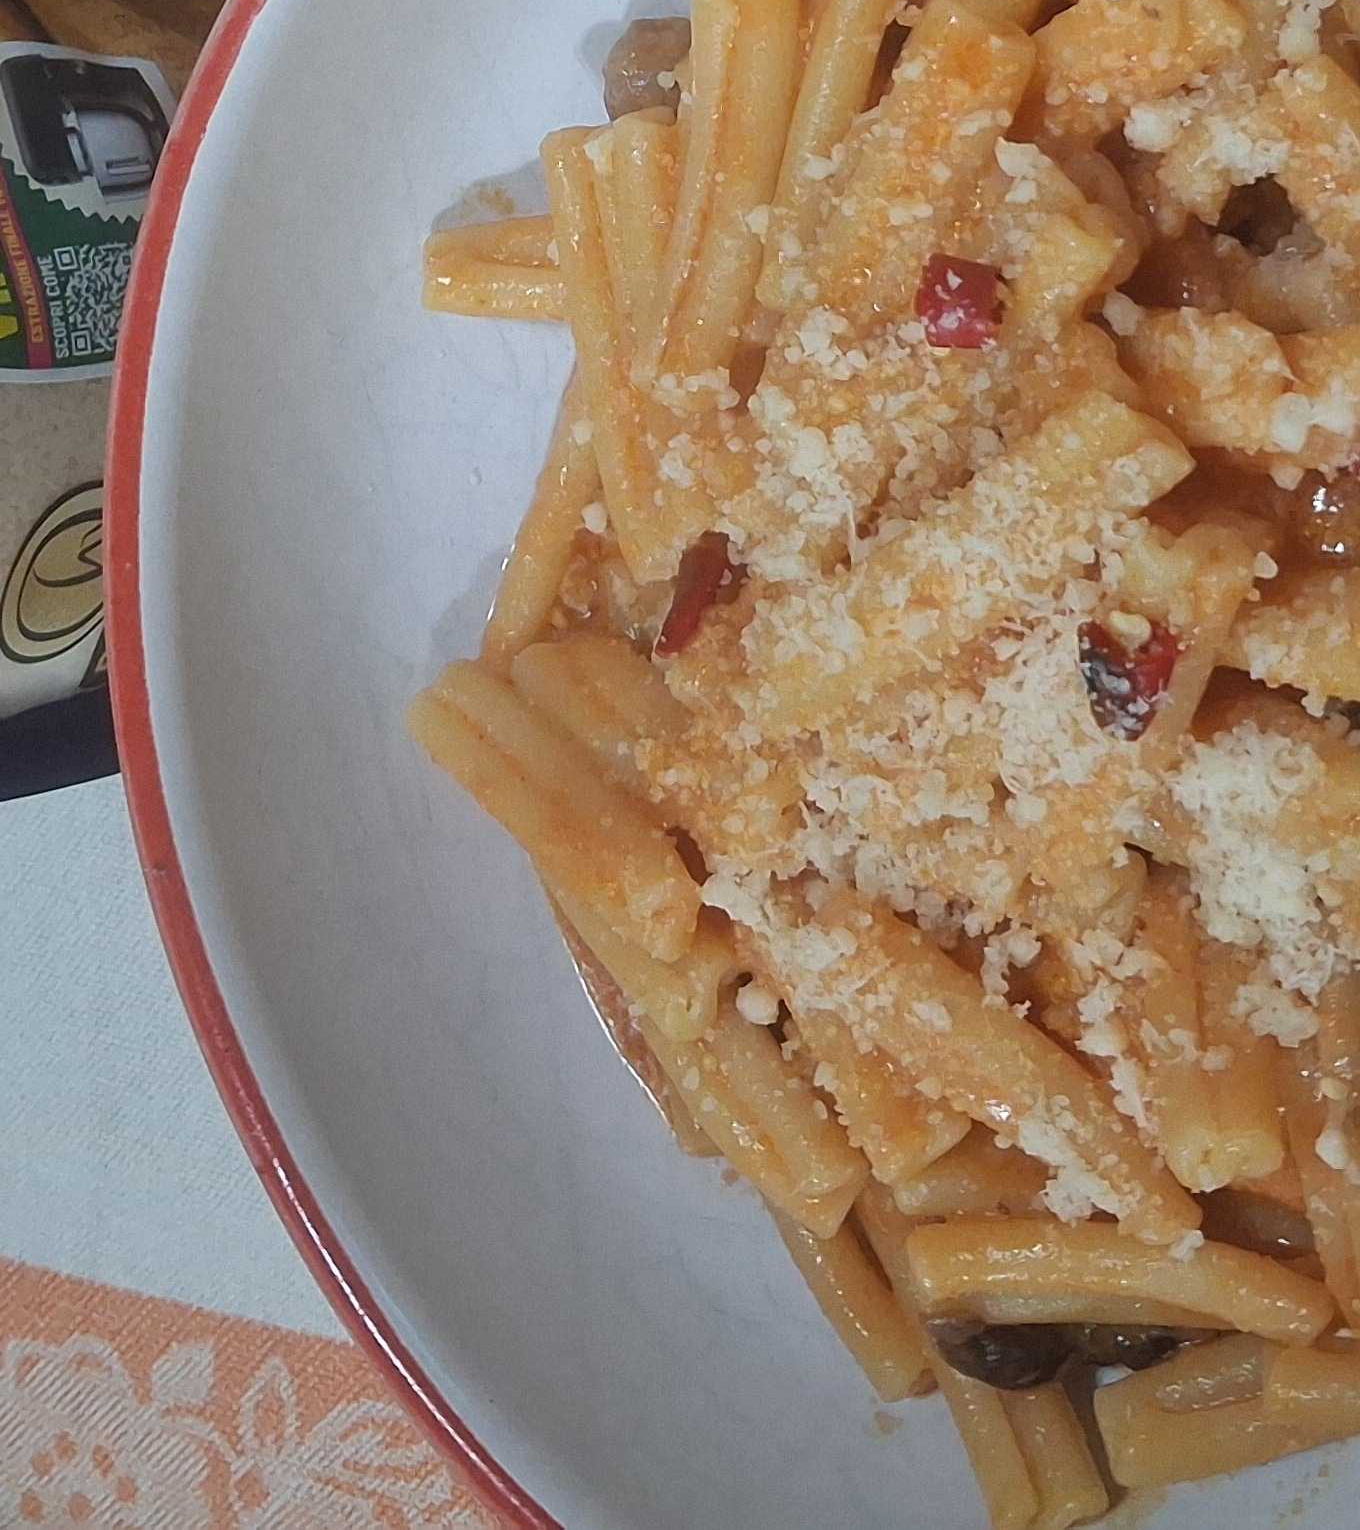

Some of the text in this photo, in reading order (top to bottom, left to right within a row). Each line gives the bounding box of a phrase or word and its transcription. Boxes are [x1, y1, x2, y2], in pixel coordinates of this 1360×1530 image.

[0, 209, 24, 255] FINALE
[13, 258, 45, 342] ESTRAZIONE
[36, 253, 70, 358] SCOPRI COME
